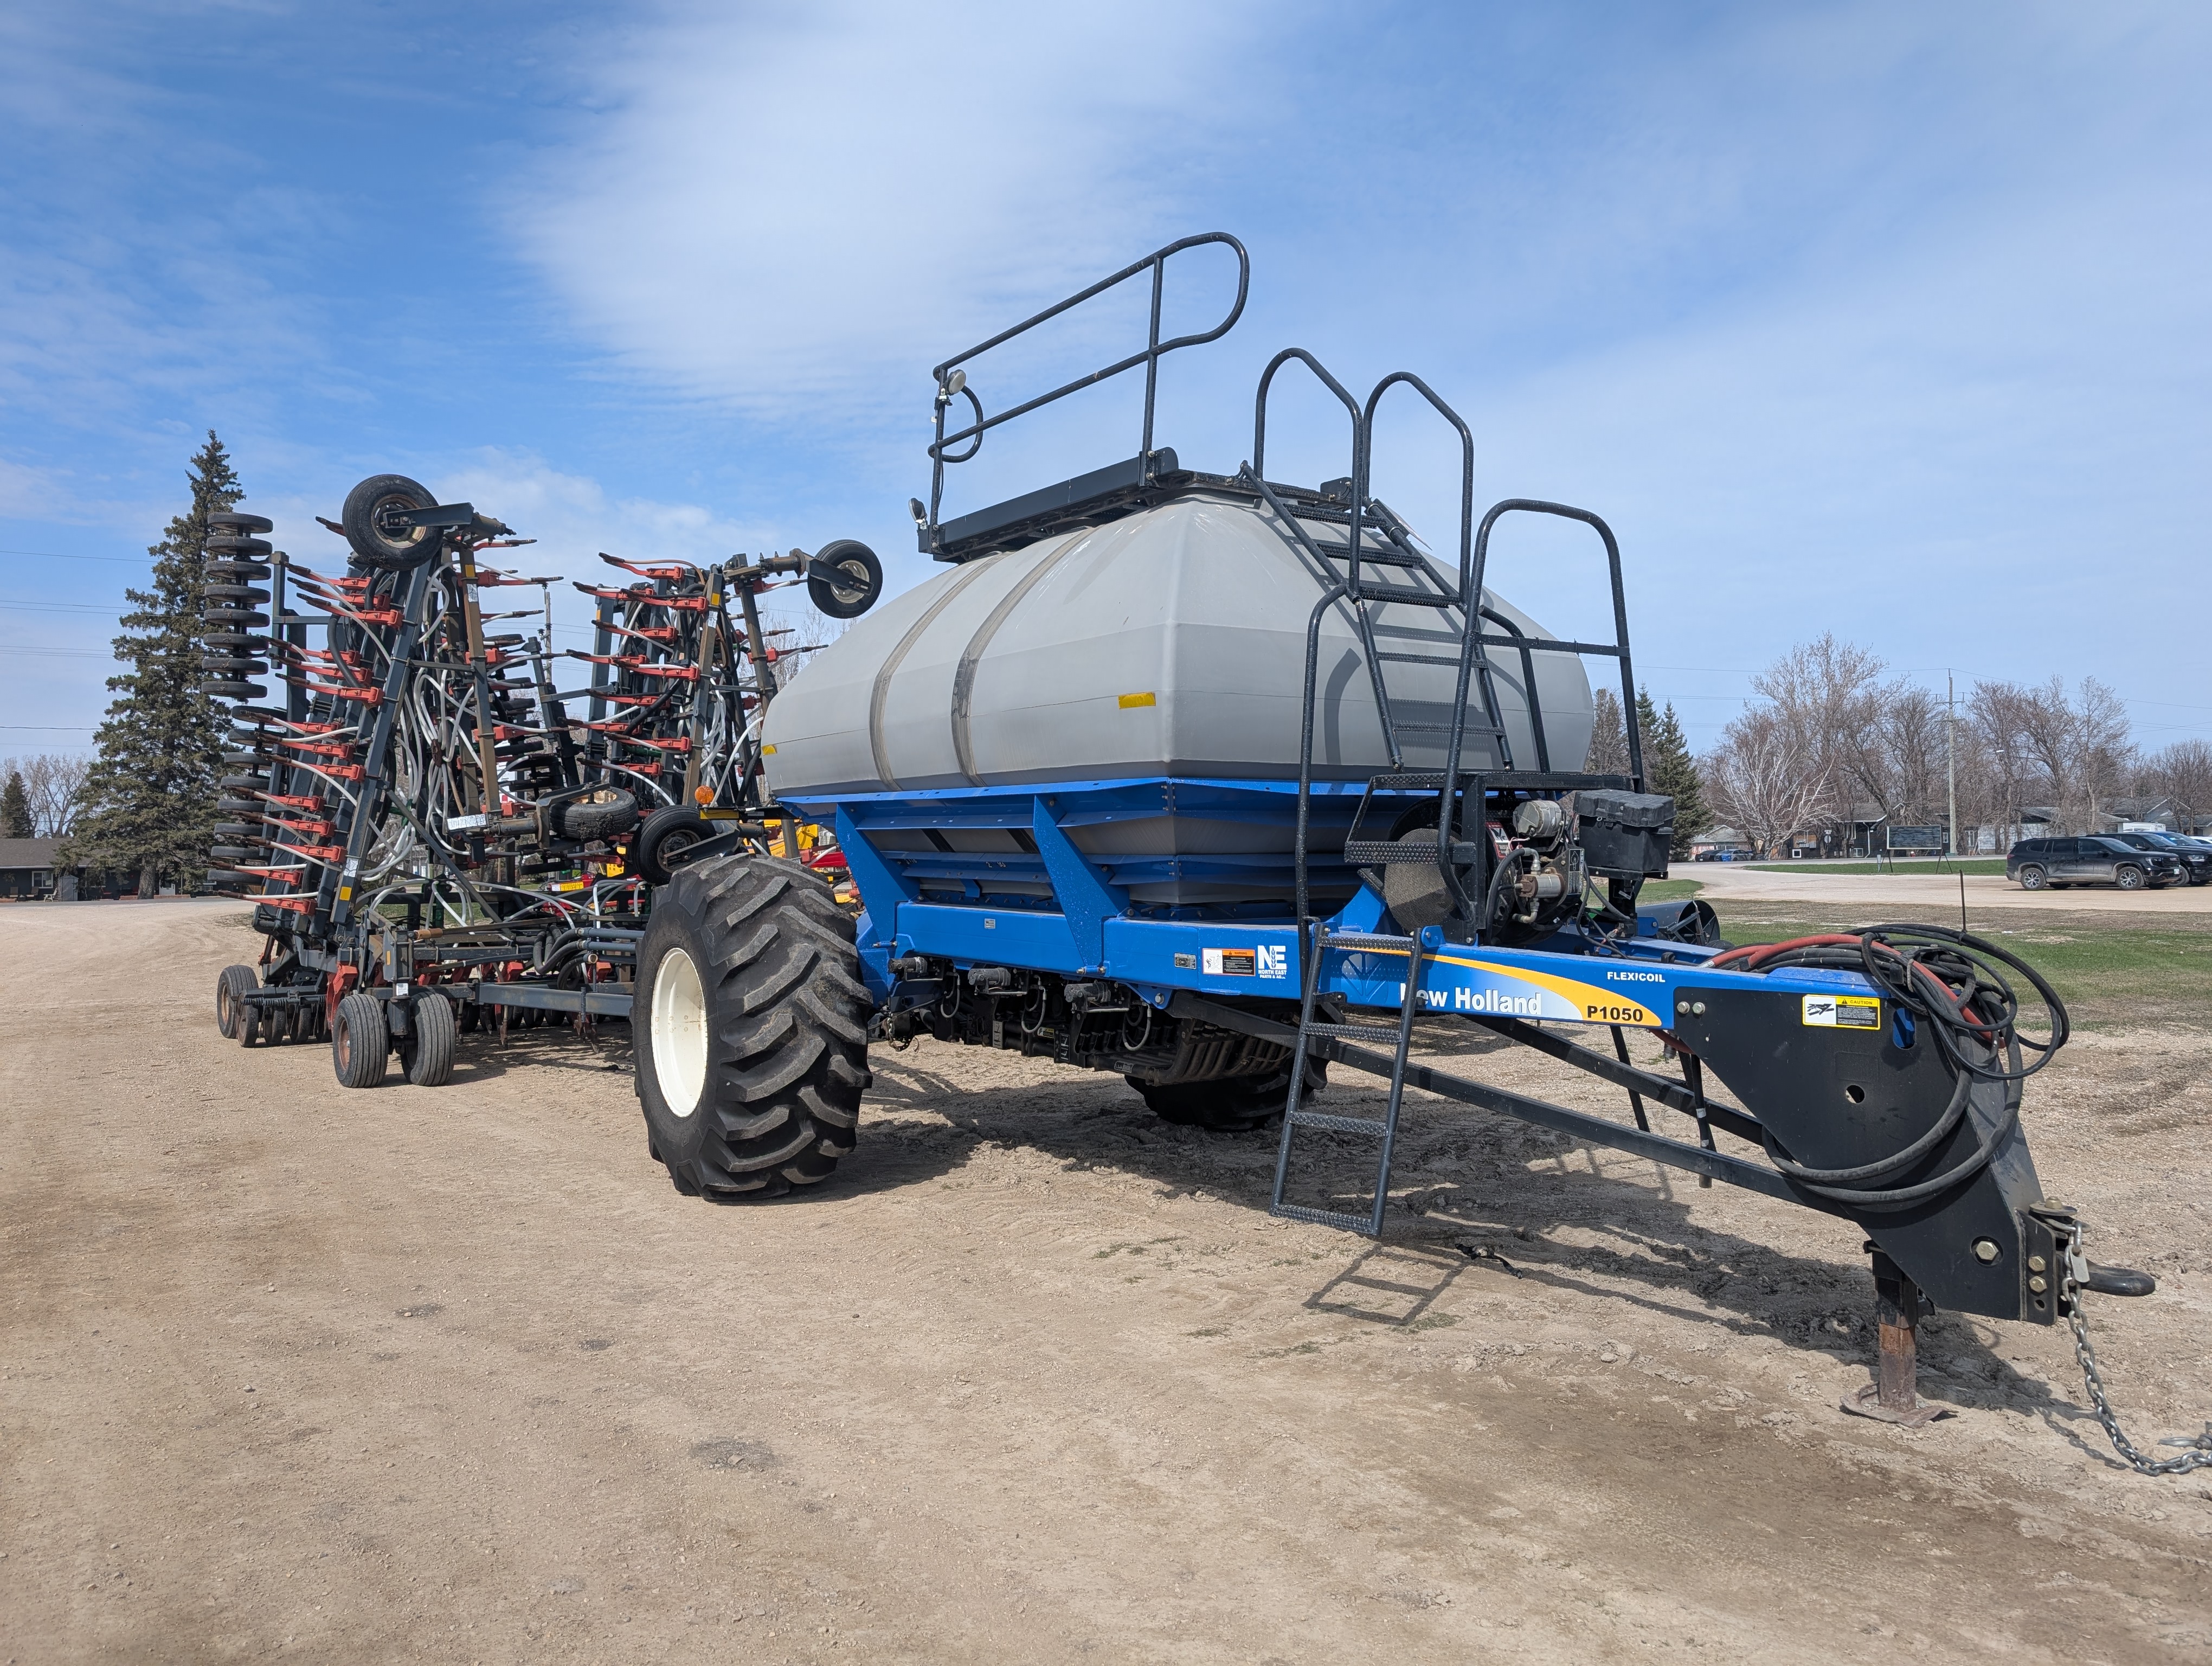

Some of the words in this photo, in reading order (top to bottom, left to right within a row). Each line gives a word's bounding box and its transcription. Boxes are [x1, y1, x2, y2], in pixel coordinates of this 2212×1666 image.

[1607, 971, 1666, 983] FLEXICOIL
[1455, 986, 1541, 1015] Holland
[1587, 1005, 1643, 1022] P1050
